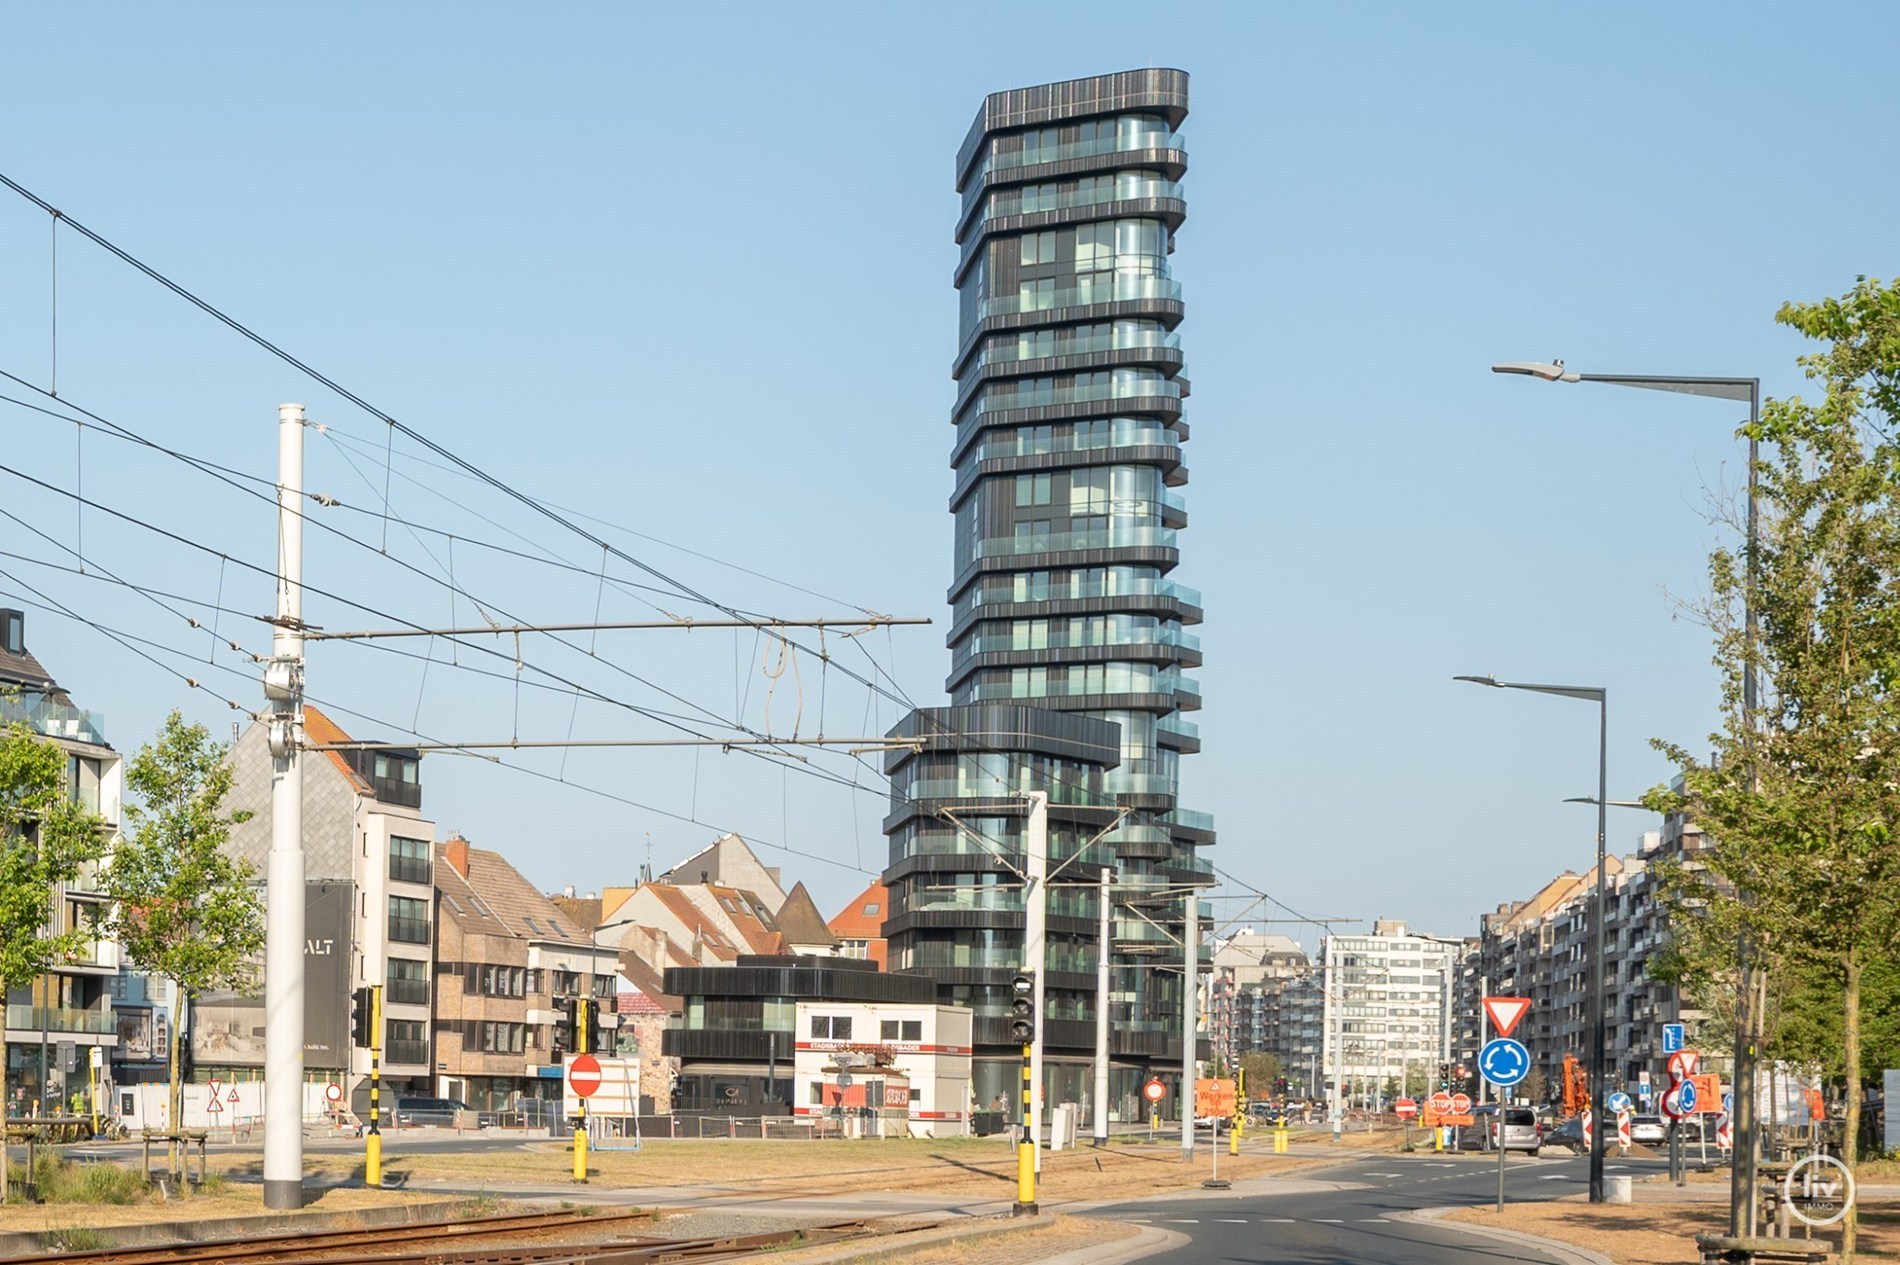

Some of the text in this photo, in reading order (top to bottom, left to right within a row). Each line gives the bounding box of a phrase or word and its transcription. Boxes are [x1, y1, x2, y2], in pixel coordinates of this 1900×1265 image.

[1200, 1091, 1233, 1100] Werken
[1430, 1099, 1451, 1108] STOP
[1451, 1100, 1469, 1108] STOP
